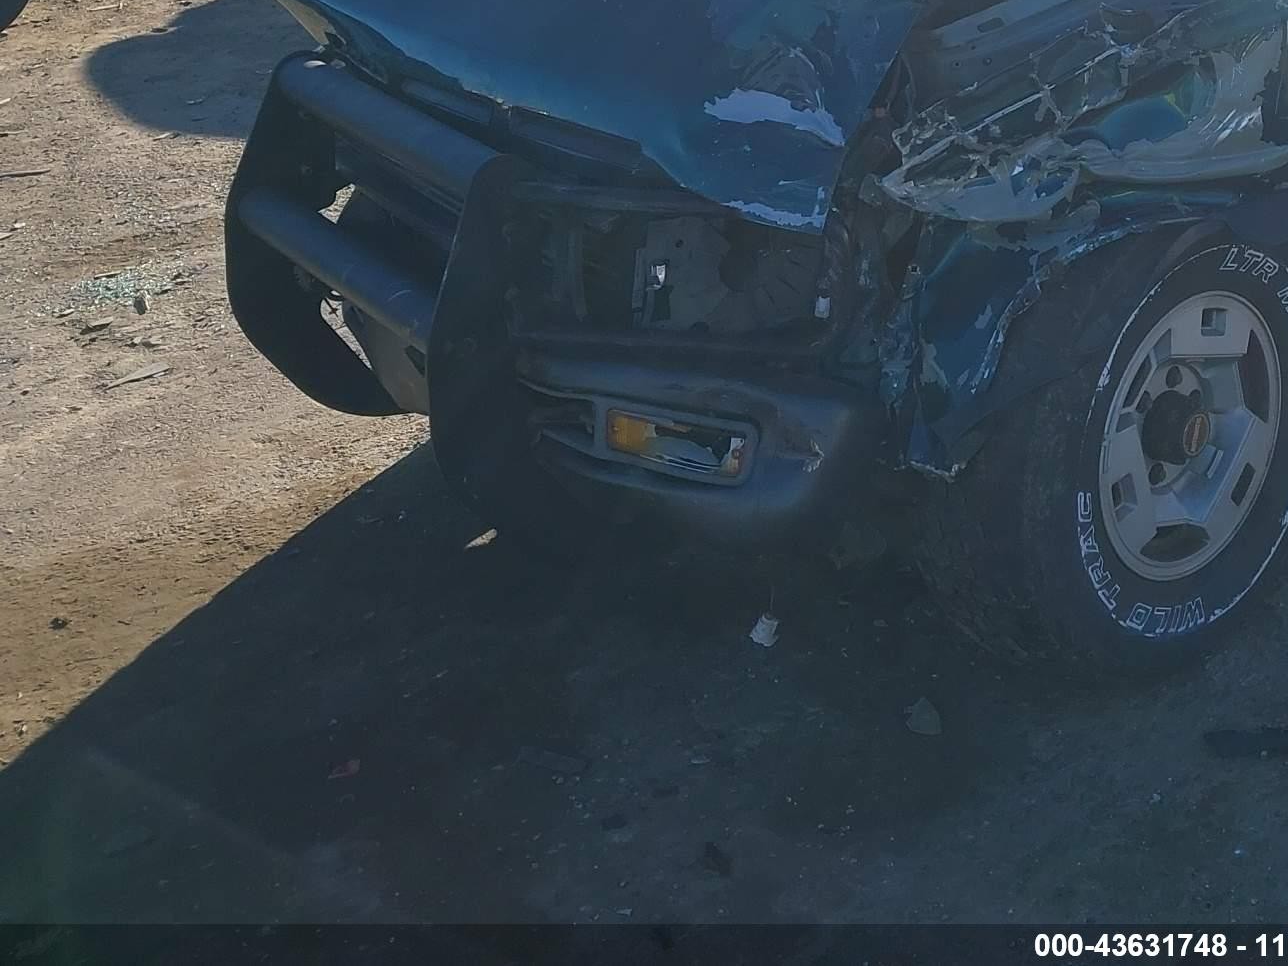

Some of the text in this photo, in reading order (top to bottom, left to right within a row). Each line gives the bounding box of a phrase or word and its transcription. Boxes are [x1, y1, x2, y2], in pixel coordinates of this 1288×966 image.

[1219, 245, 1279, 283] LTR
[1077, 491, 1206, 634] WILD TRAC
